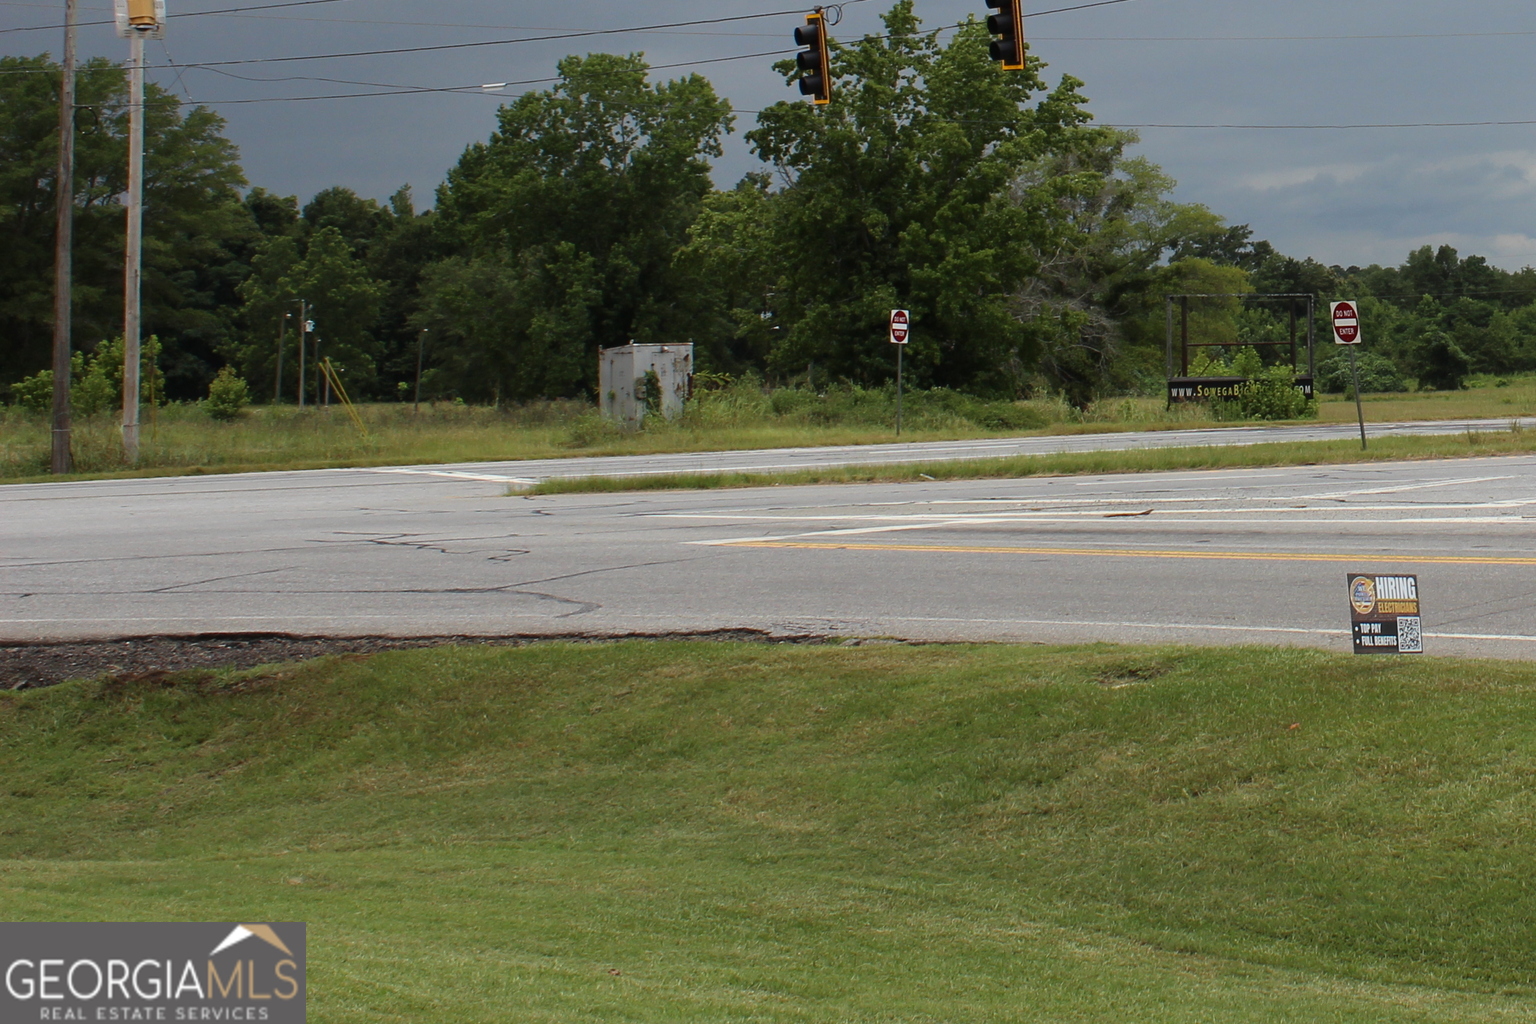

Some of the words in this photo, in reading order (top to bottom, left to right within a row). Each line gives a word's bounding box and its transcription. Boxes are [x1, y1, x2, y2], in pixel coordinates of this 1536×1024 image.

[1343, 309, 1353, 317] NOT
[1375, 576, 1417, 600] HIRING
[1378, 602, 1418, 613] ELECTRICIANS
[1360, 623, 1371, 634] TOP
[1371, 623, 1382, 634] PAY
[1361, 636, 1374, 647] FULL
[1374, 636, 1398, 647] BENEFITS
